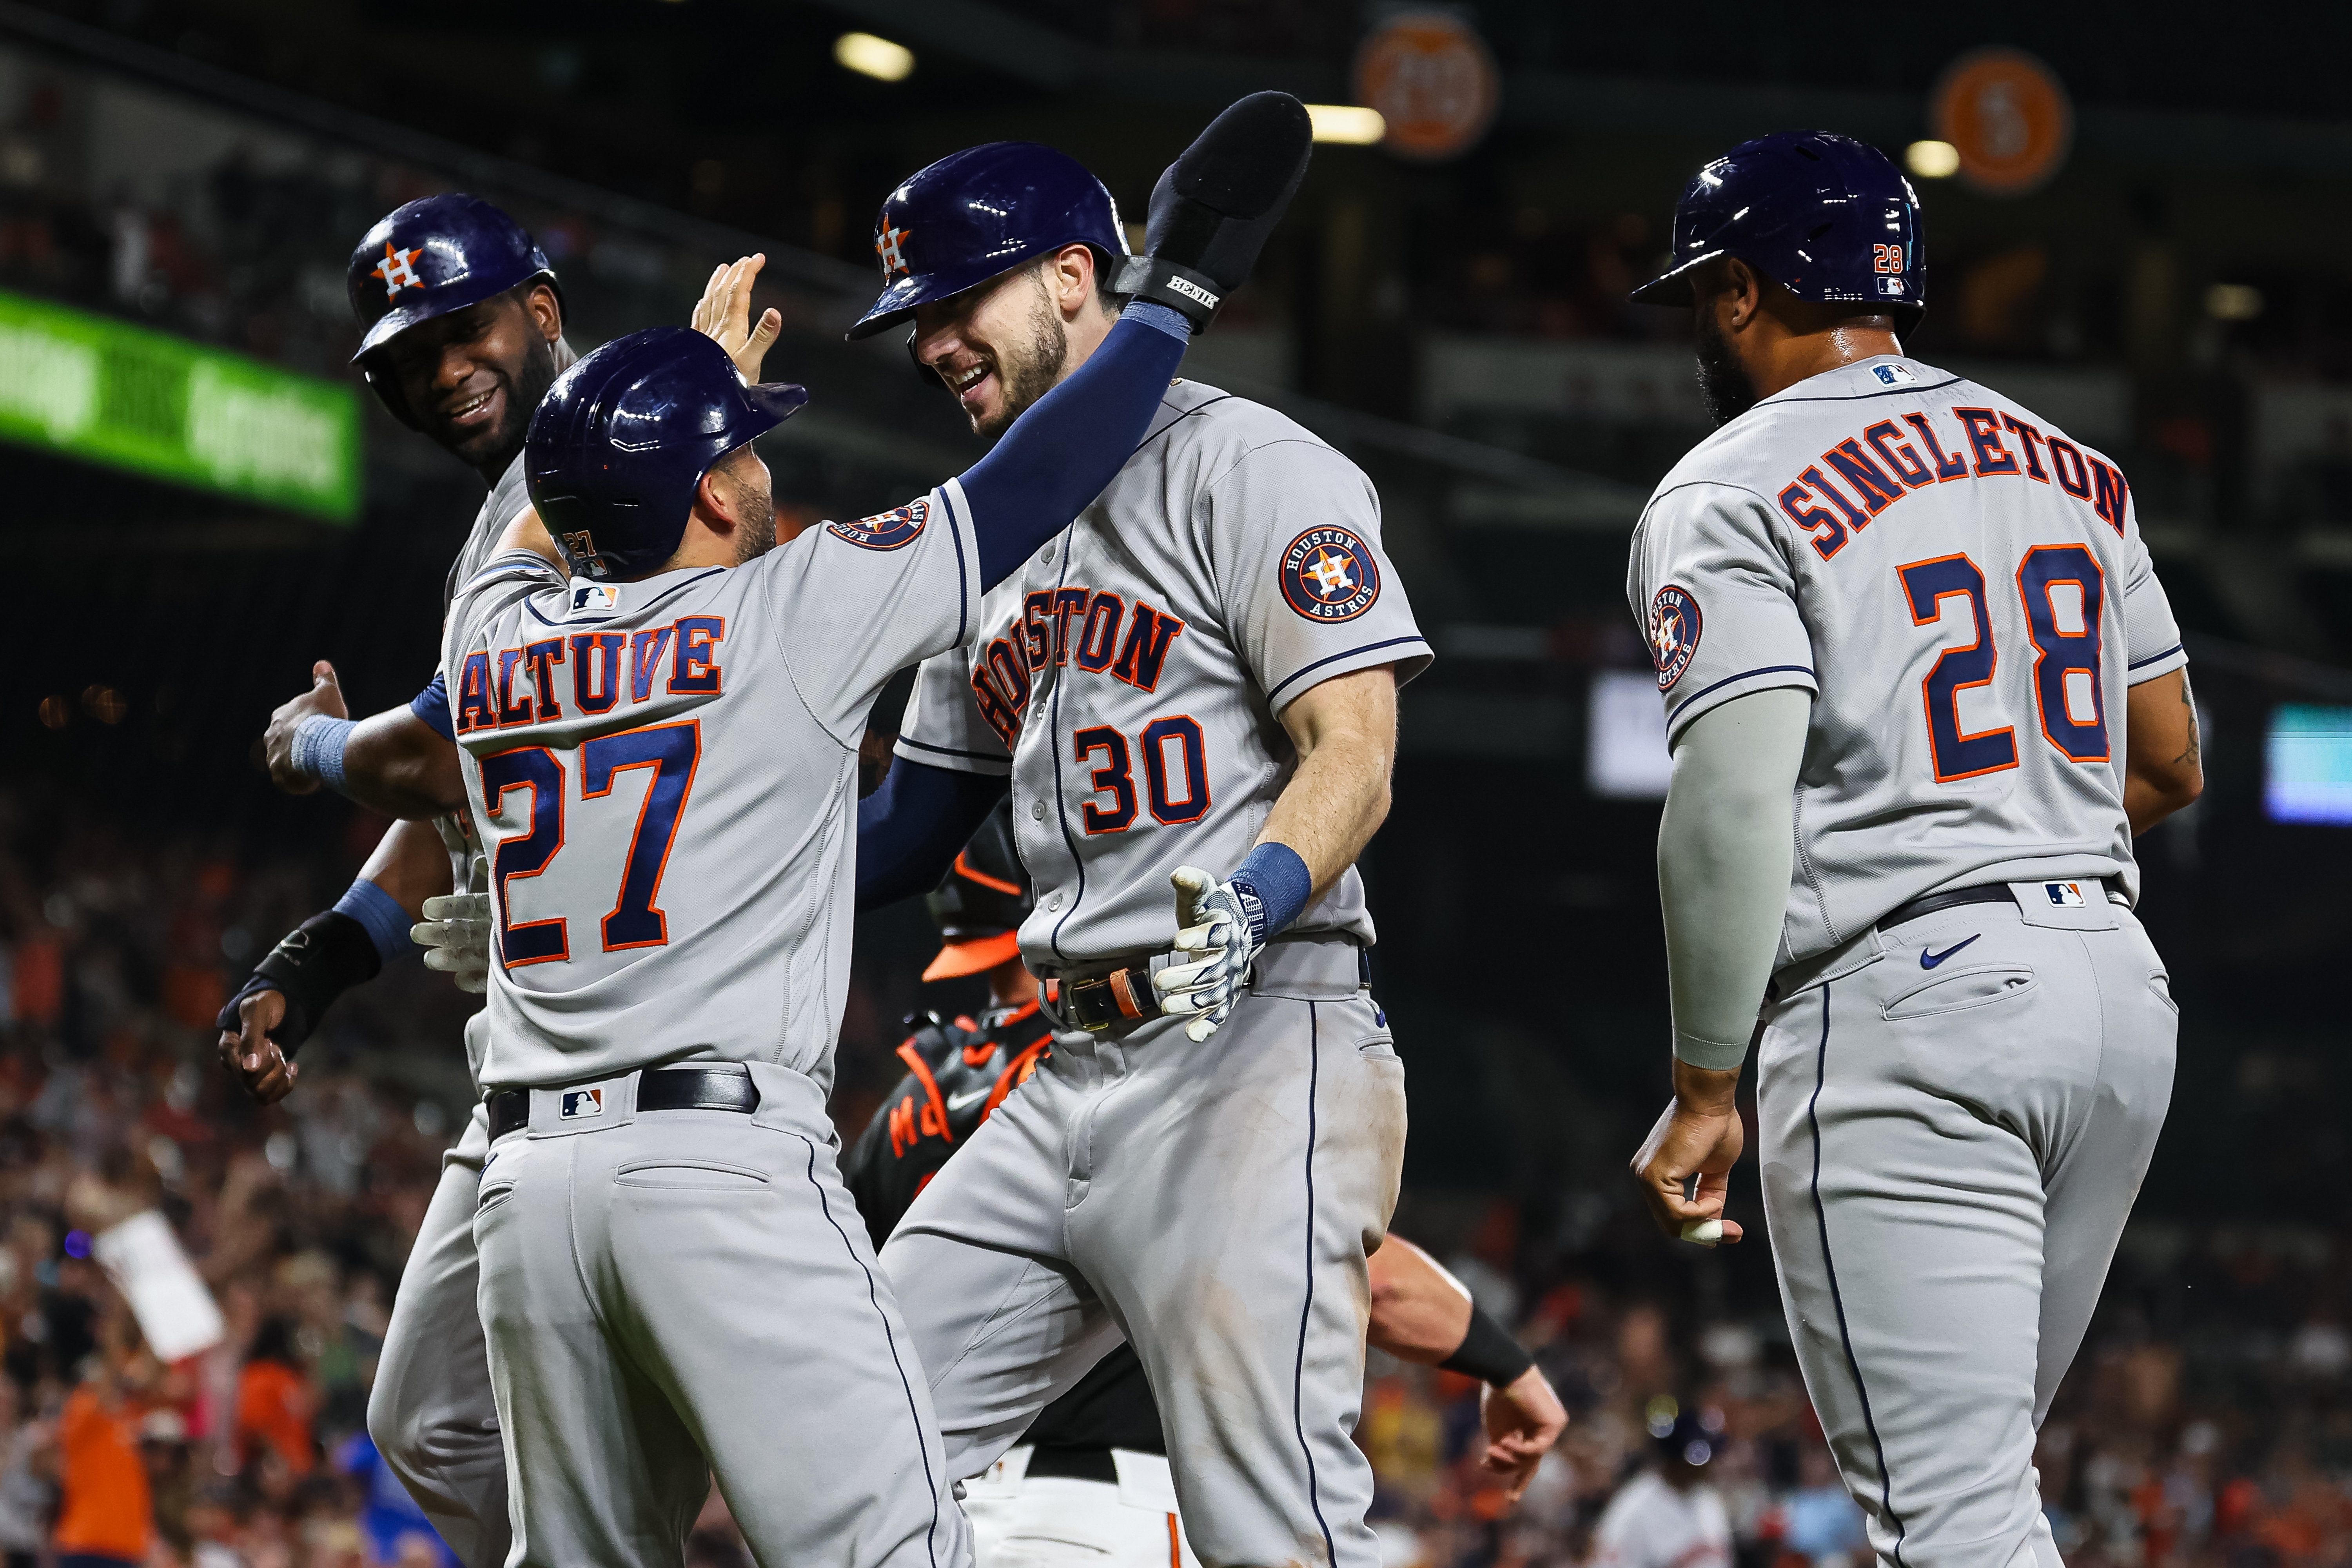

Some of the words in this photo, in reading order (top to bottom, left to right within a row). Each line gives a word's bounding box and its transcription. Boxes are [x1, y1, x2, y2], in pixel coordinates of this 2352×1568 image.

[376, 247, 420, 296] H
[878, 227, 907, 274] H
[1873, 244, 1903, 274] 28
[1166, 275, 1220, 310] BENIK
[1778, 407, 2129, 561] SINGLETON
[562, 530, 597, 559] 27
[1286, 531, 1357, 571] HOUSTON
[1308, 554, 1354, 596] H
[1310, 585, 1373, 617] ASTROS
[457, 615, 725, 735] ALTUVE
[1896, 543, 2111, 783] 28
[1074, 714, 1212, 835] 30
[478, 718, 702, 969] 27
